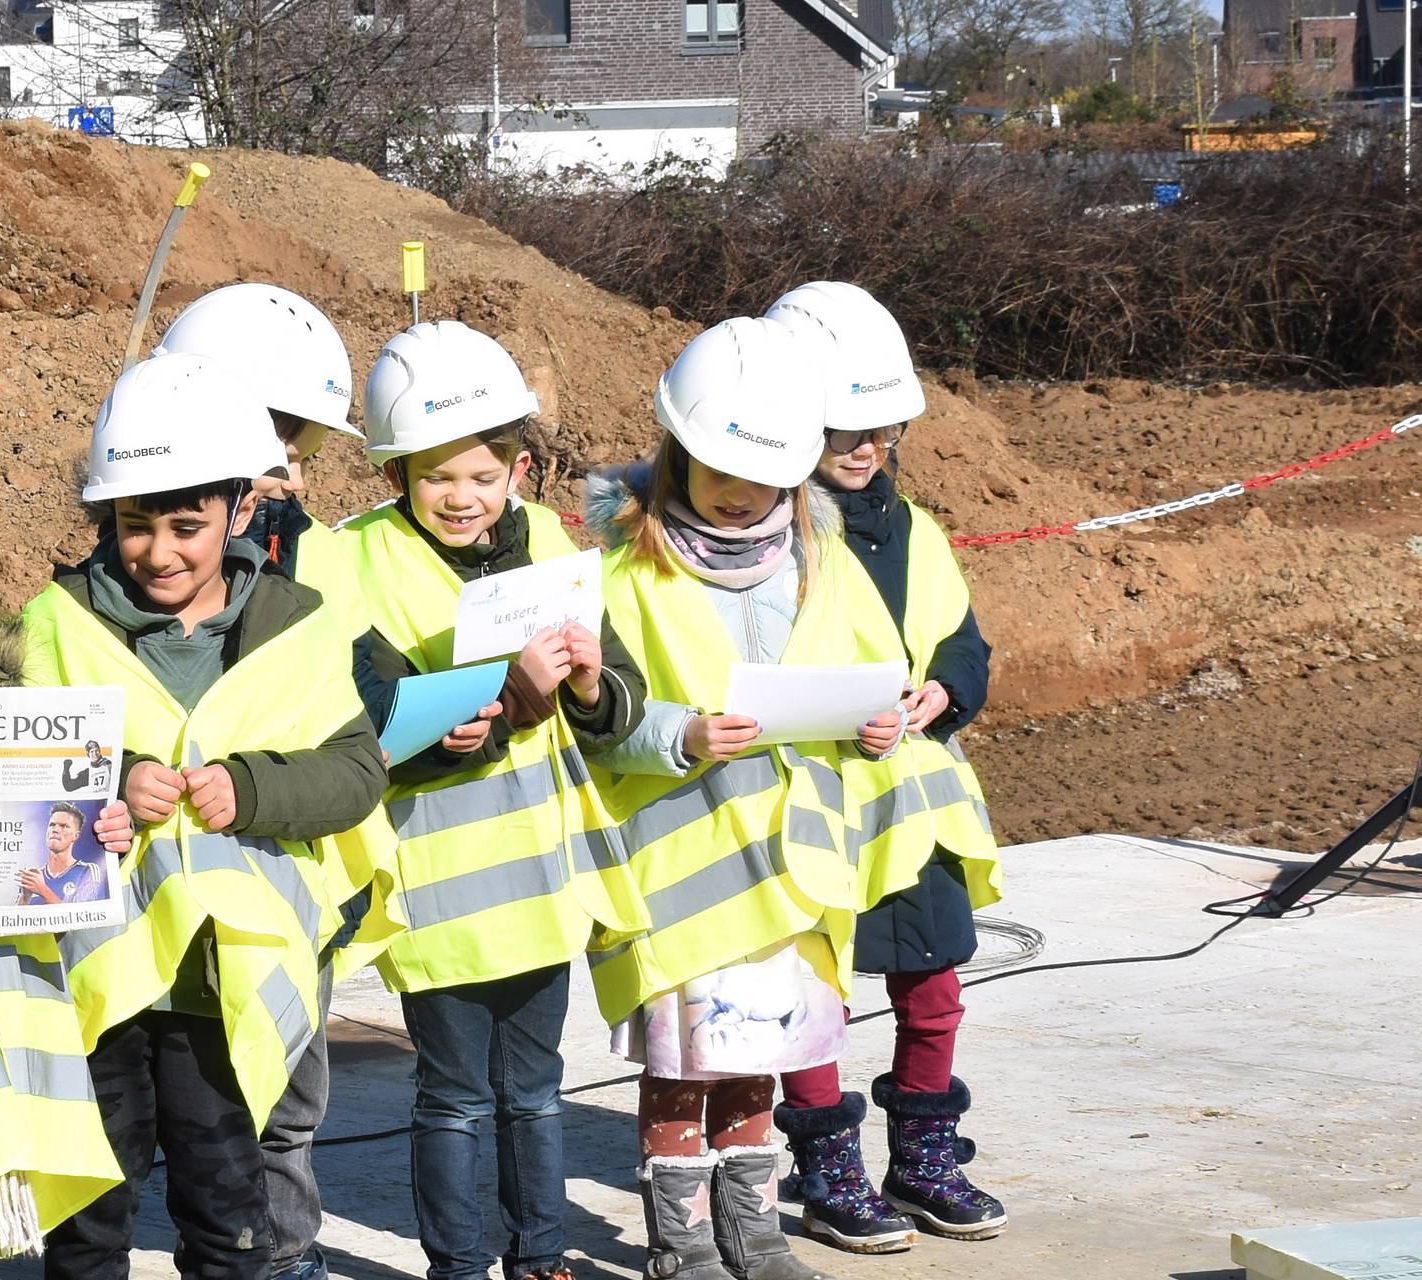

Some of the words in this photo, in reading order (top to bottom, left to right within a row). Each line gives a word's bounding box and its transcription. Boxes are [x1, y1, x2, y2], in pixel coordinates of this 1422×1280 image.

[860, 377, 902, 394] GOLDBECK
[434, 388, 488, 411] GOLDCK
[736, 429, 787, 450] GOLDBECK
[114, 445, 171, 462] GOLDBECK
[12, 715, 87, 741] POST
[93, 775, 105, 787] 47
[1, 914, 46, 928] Bahnen
[49, 912, 73, 926] und
[77, 910, 107, 924] Kitas
